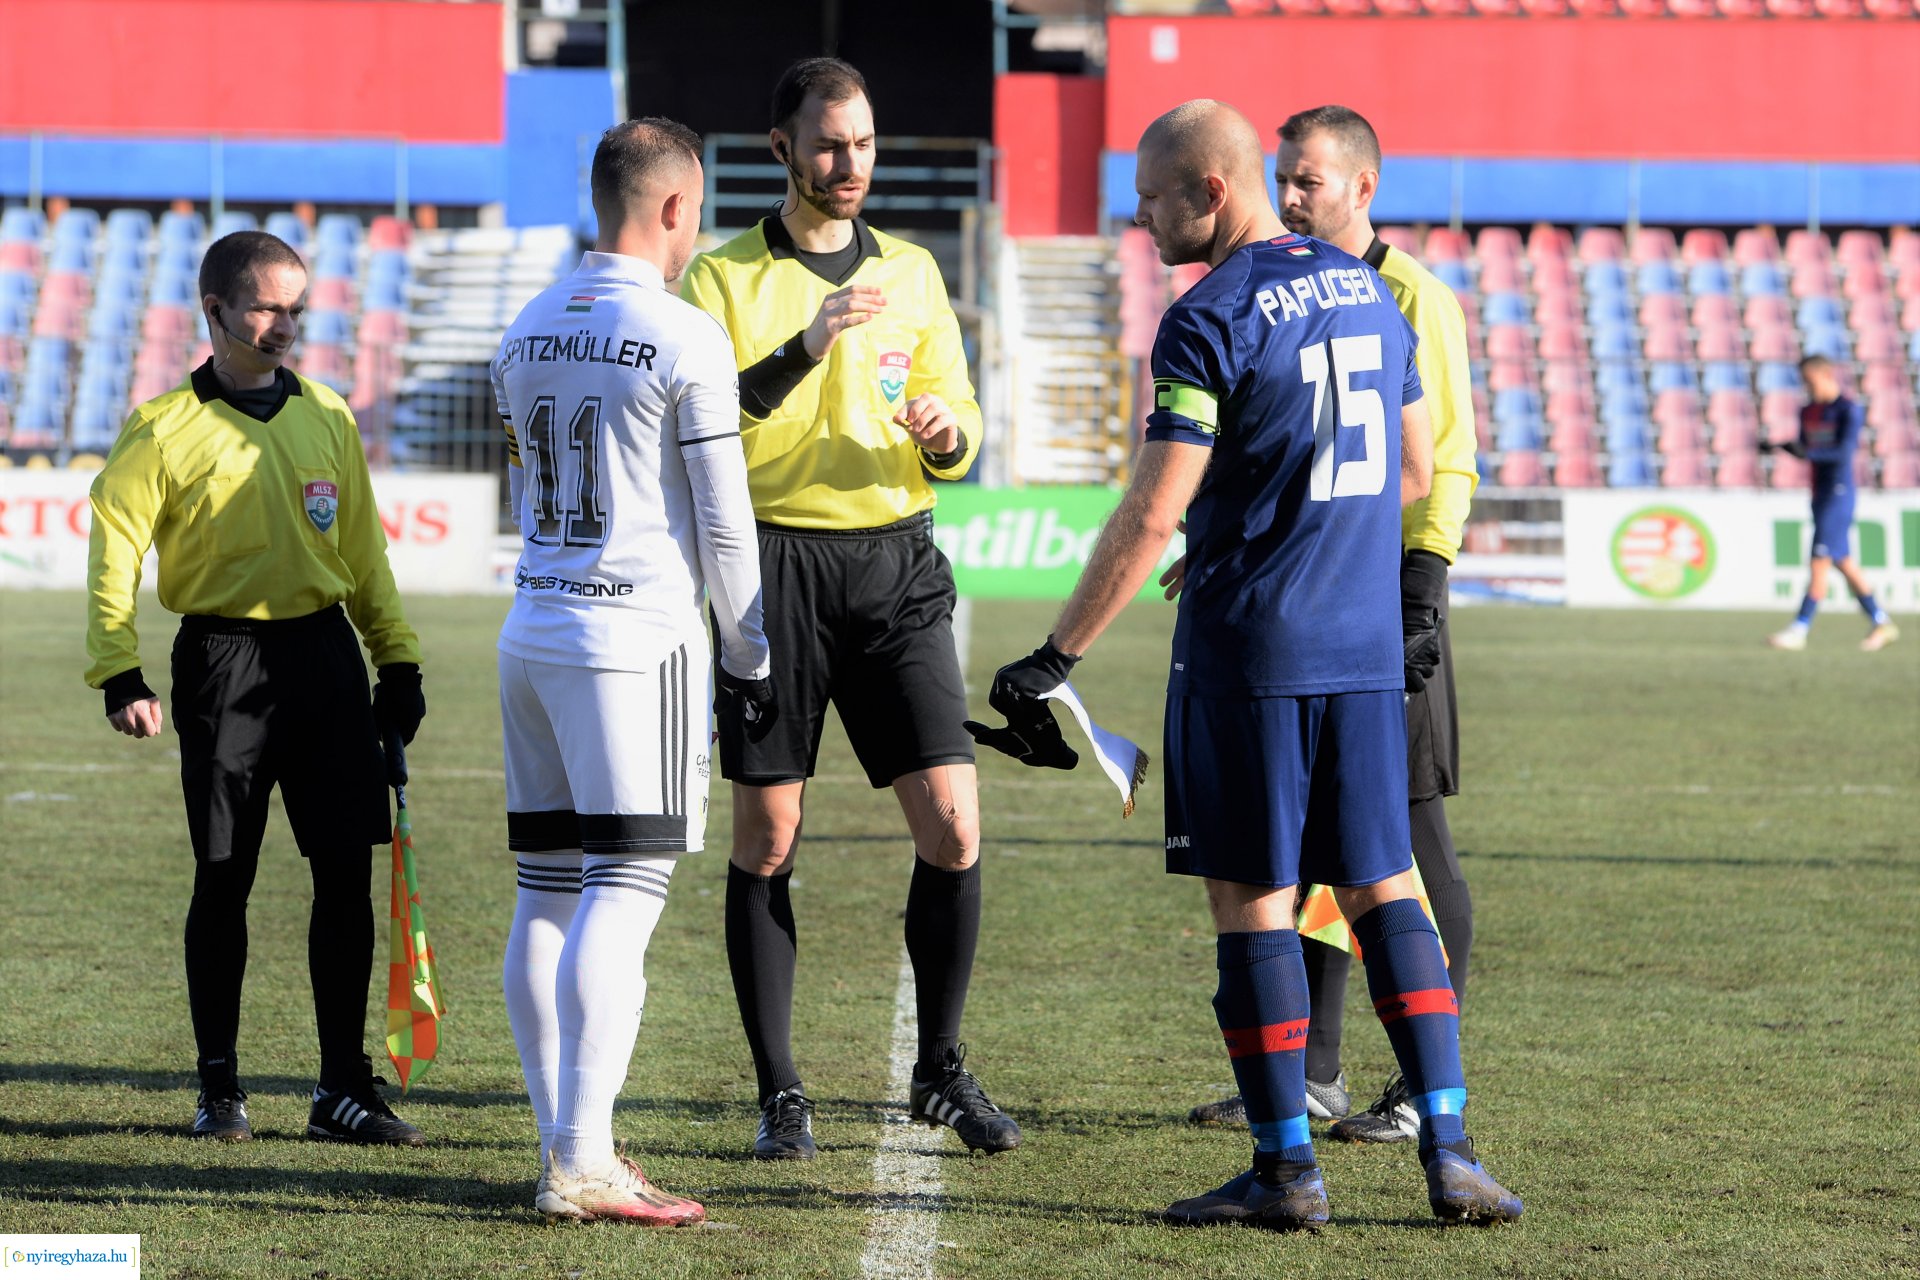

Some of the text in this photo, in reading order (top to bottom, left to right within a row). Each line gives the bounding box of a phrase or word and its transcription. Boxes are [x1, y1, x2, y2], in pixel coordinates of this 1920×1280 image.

[1255, 267, 1382, 327] PAPUCSEK
[503, 329, 658, 372] SPITZMÜLLER
[1299, 333, 1387, 502] 15
[312, 485, 332, 495] MLSZ
[524, 395, 607, 548] 11
[528, 575, 634, 597] BESTRONG
[1166, 835, 1191, 850] JAK
